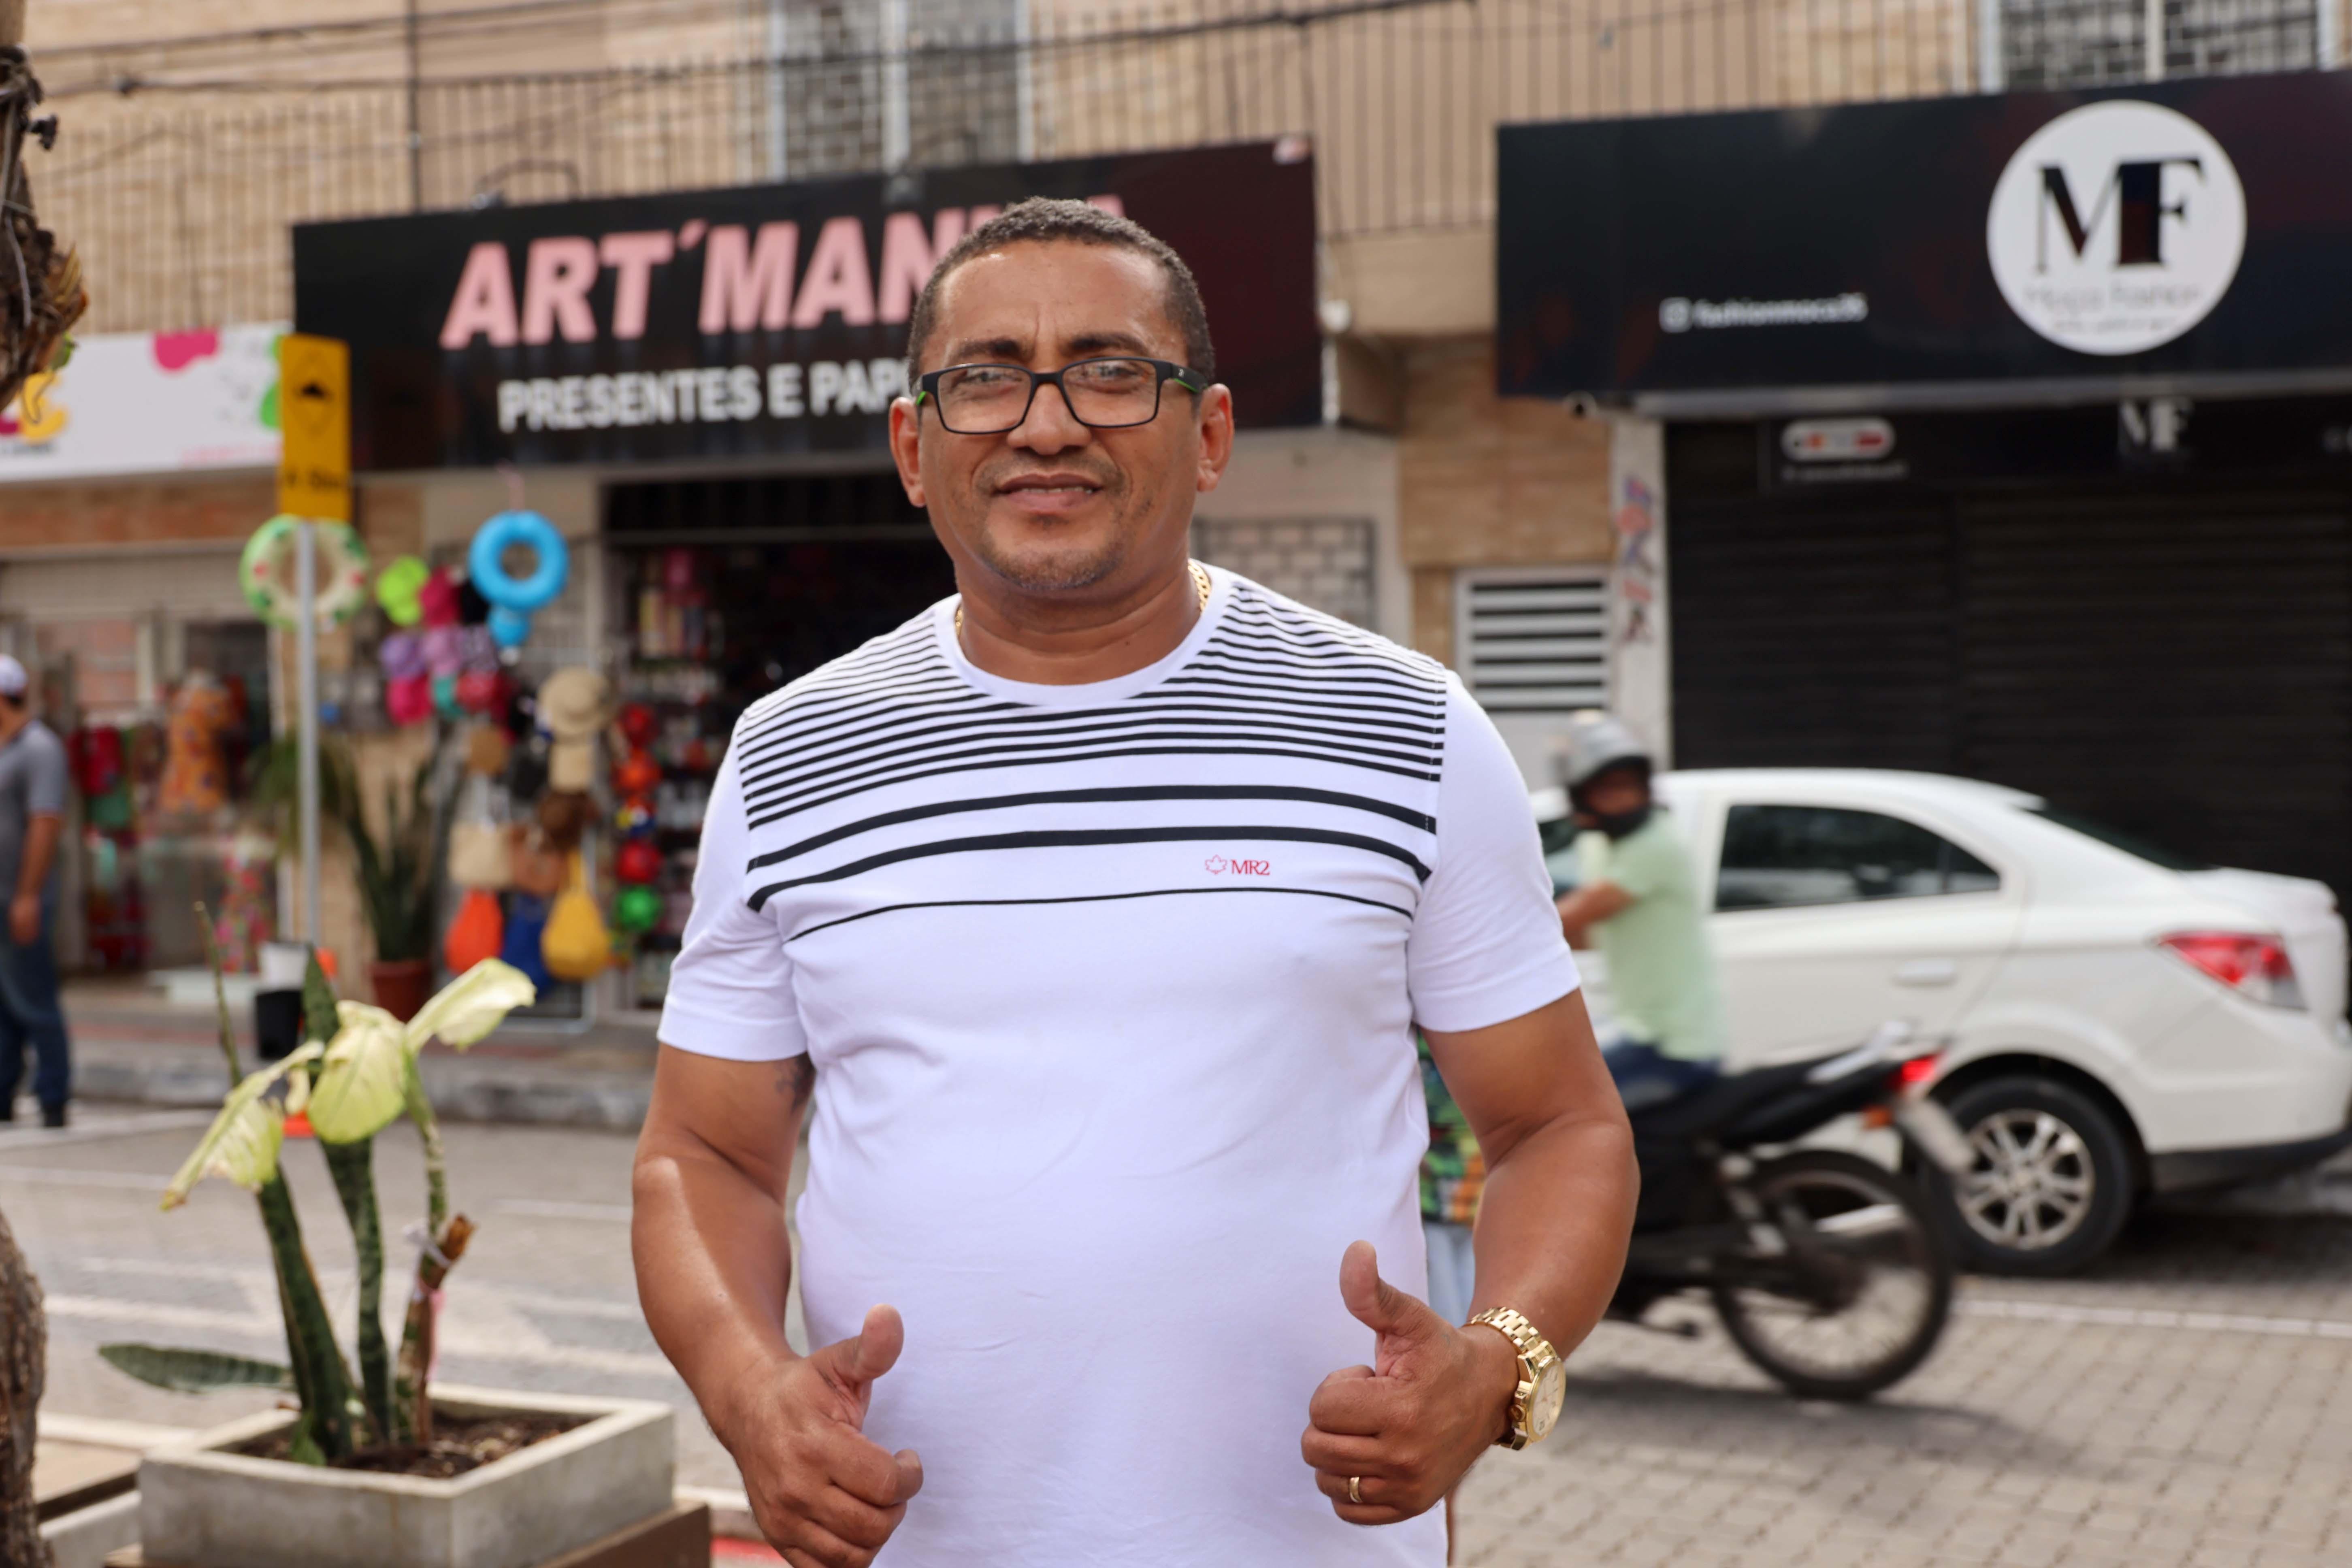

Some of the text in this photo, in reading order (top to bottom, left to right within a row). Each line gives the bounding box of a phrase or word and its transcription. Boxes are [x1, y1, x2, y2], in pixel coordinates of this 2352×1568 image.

[2035, 156, 2208, 275] MF
[496, 364, 763, 434] PRESENTES
[766, 361, 805, 419] E
[1231, 859, 1270, 876] MR2
